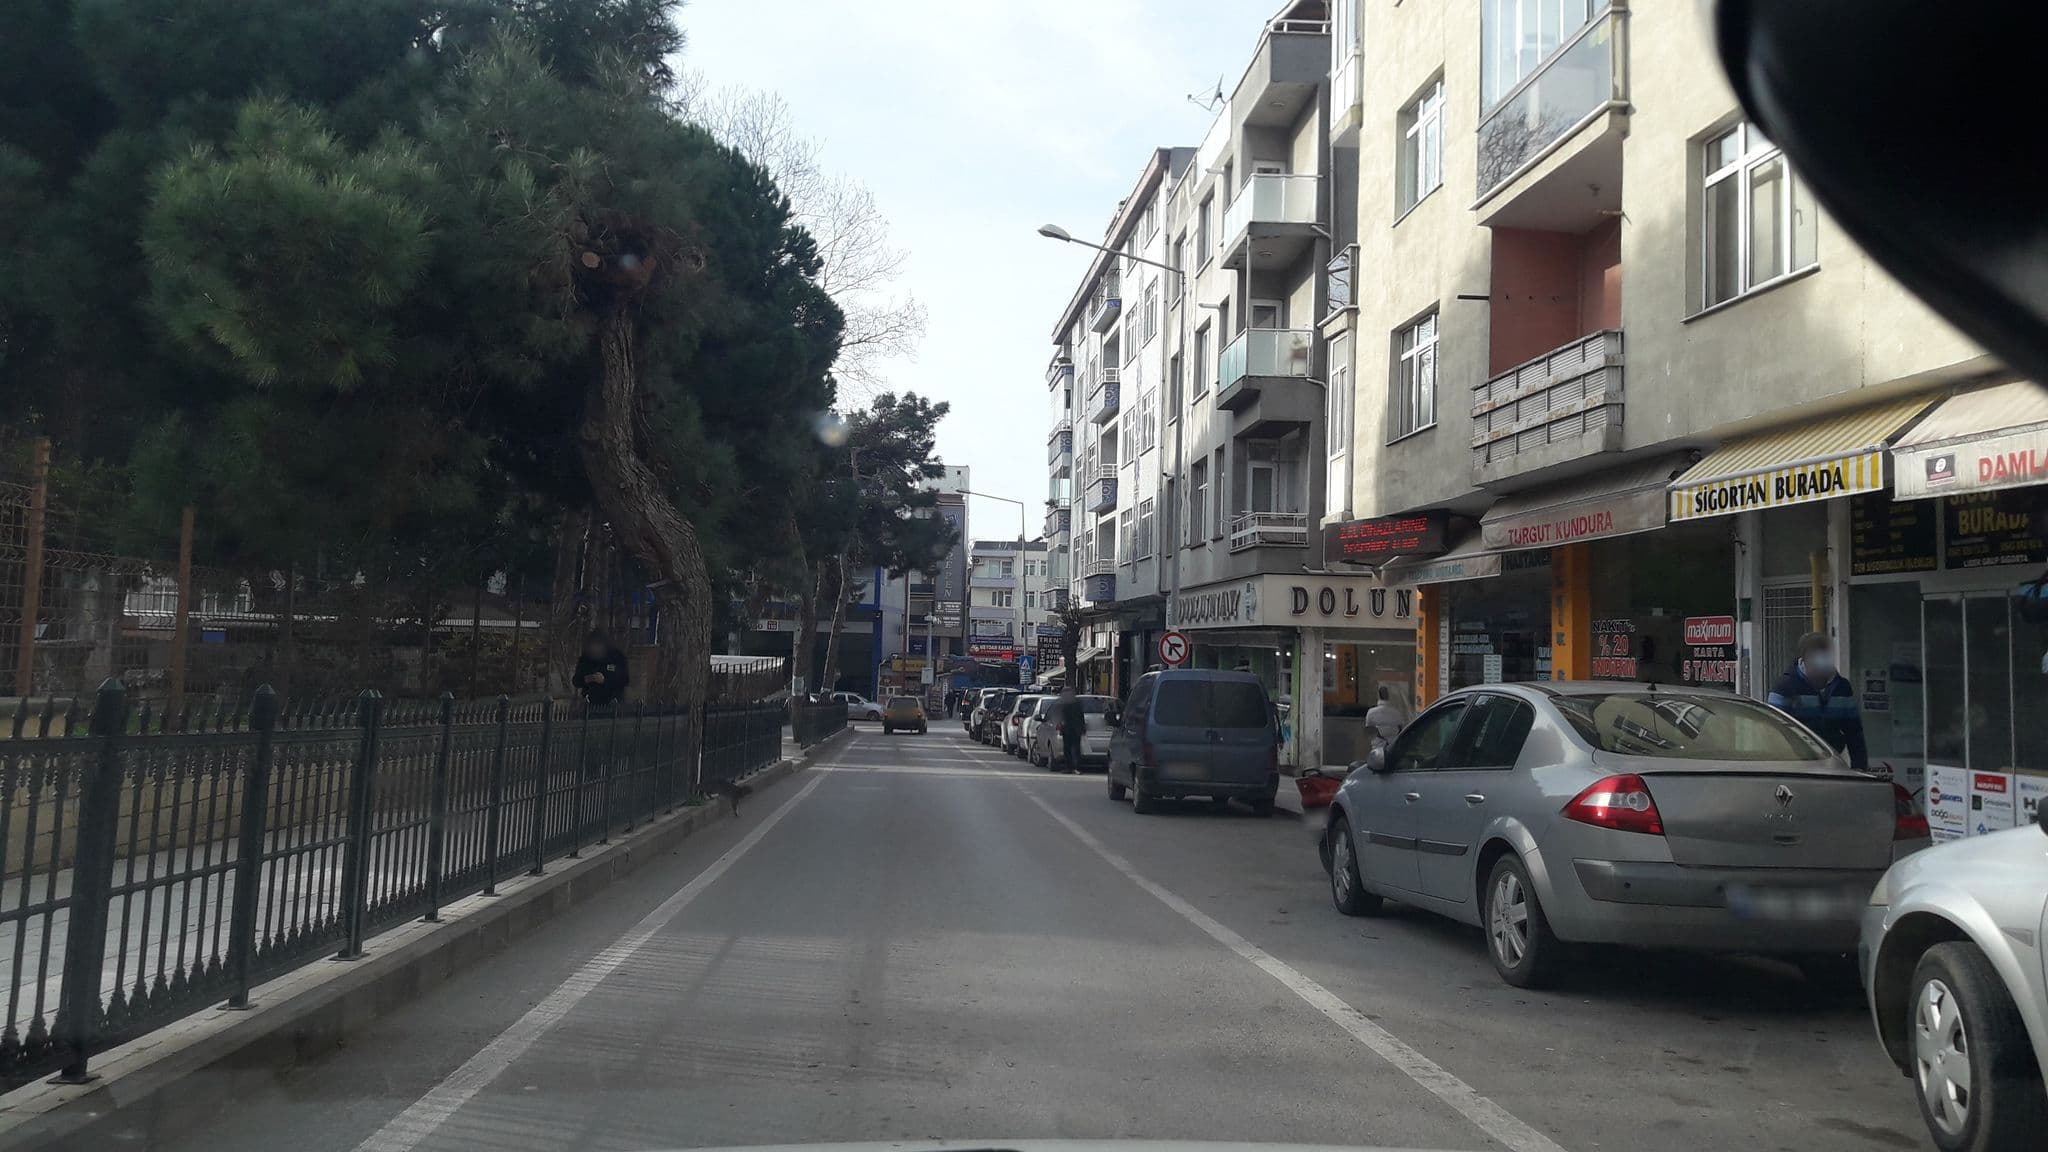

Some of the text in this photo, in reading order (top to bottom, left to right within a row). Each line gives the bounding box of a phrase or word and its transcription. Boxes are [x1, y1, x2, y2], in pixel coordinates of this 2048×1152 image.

[1695, 466, 1845, 514] SİGORTAN BURADA
[1508, 510, 1614, 546] TURGUT KUNDURA
[1612, 634, 1630, 656] 20
[1693, 647, 1725, 658] KARTA
[1682, 659, 1736, 683] 5 TAKSİT
